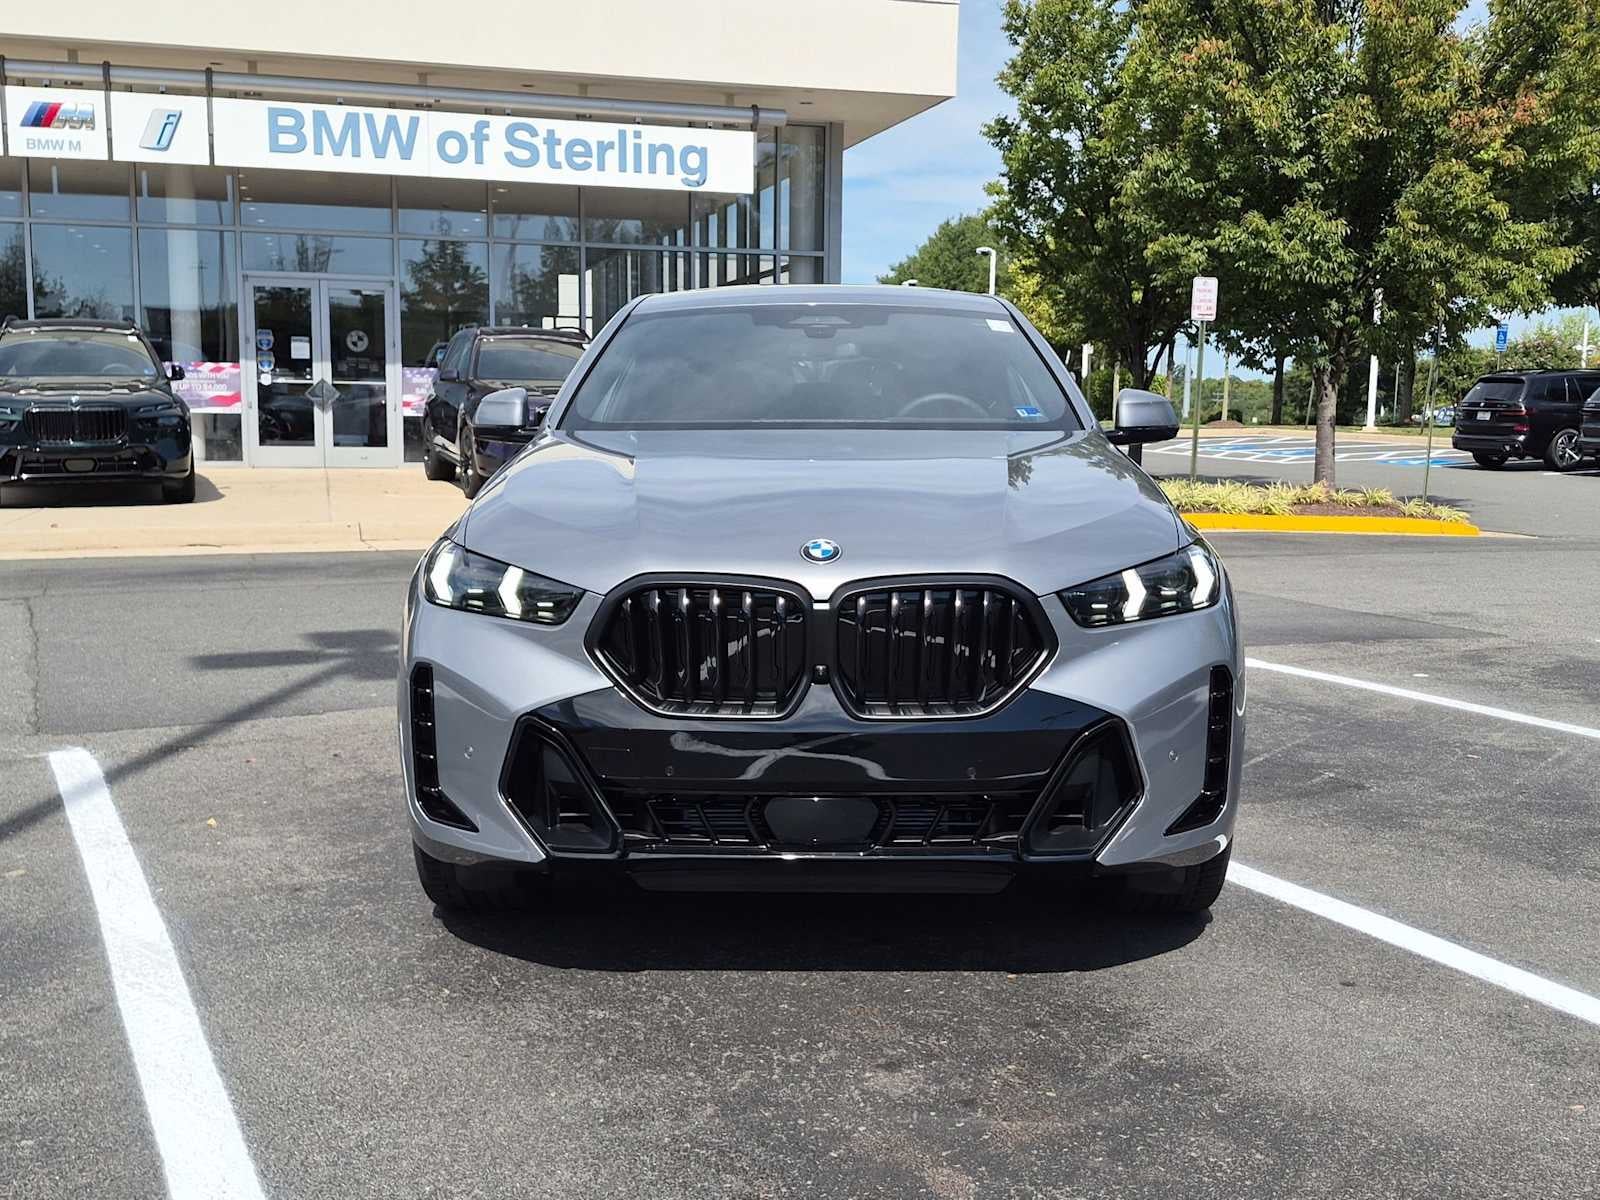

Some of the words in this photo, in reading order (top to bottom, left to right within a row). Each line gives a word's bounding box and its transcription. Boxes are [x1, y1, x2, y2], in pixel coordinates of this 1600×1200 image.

[26, 137, 65, 152] BMW
[68, 139, 82, 153] M
[267, 106, 420, 160] BMW
[436, 120, 491, 165] of
[504, 121, 709, 188] Sterling
